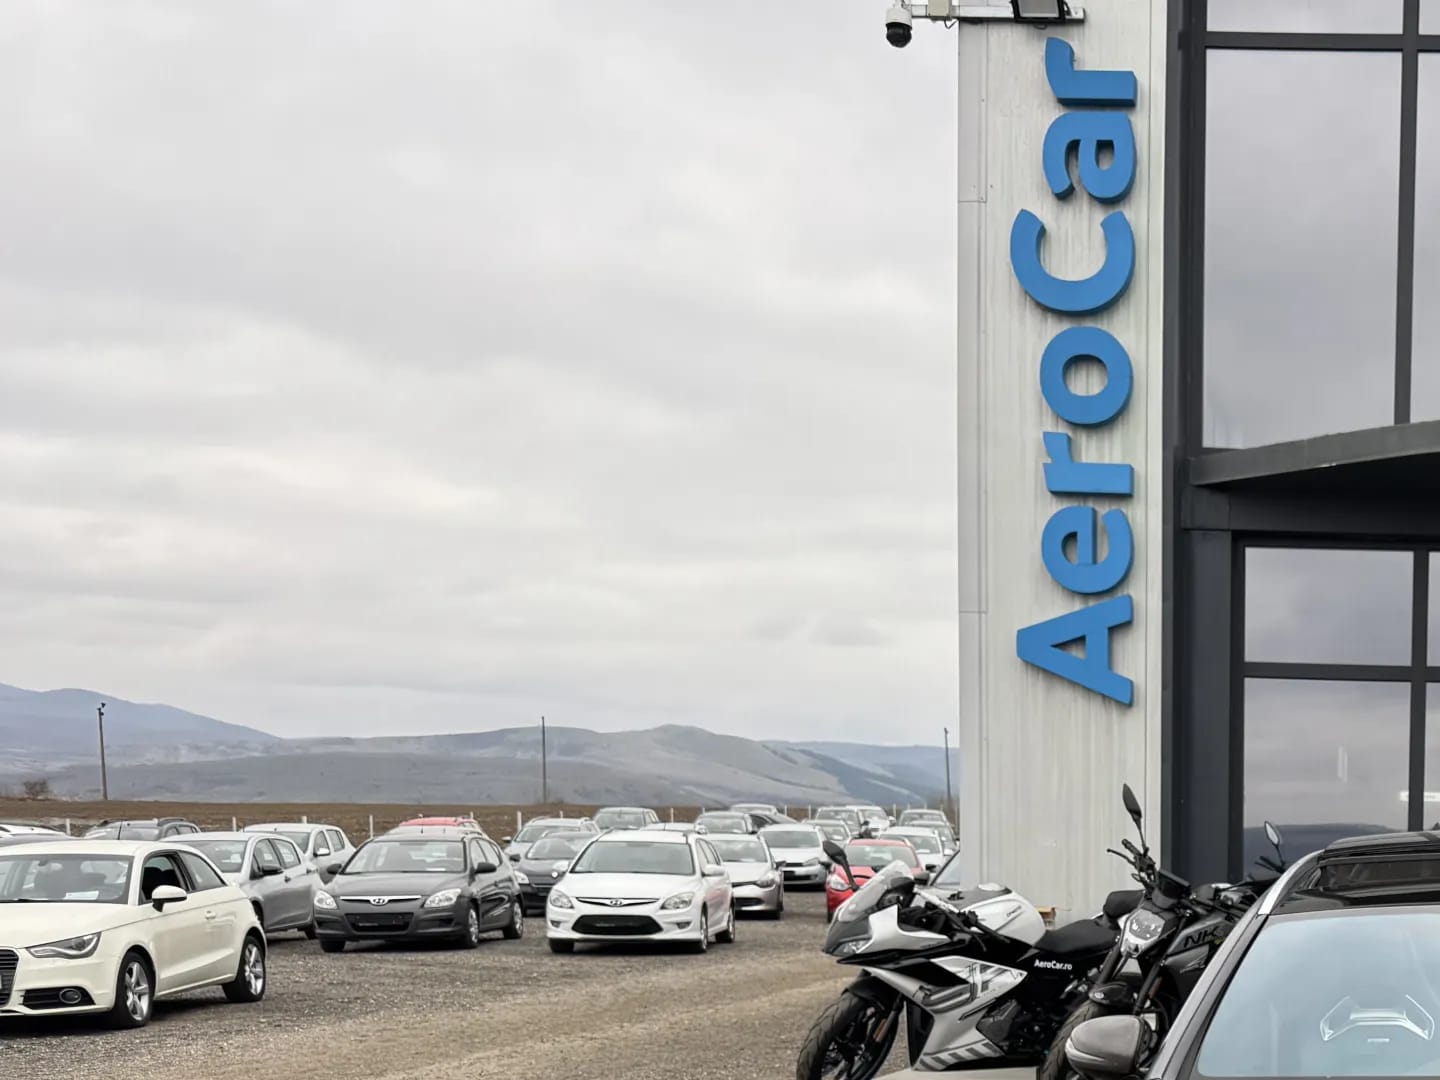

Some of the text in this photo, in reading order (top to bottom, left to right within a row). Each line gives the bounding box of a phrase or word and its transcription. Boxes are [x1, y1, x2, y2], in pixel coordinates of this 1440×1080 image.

[1010, 36, 1137, 706] AeroCar
[1183, 925, 1220, 948] NK
[1033, 958, 1073, 970] AeroCar.ro
